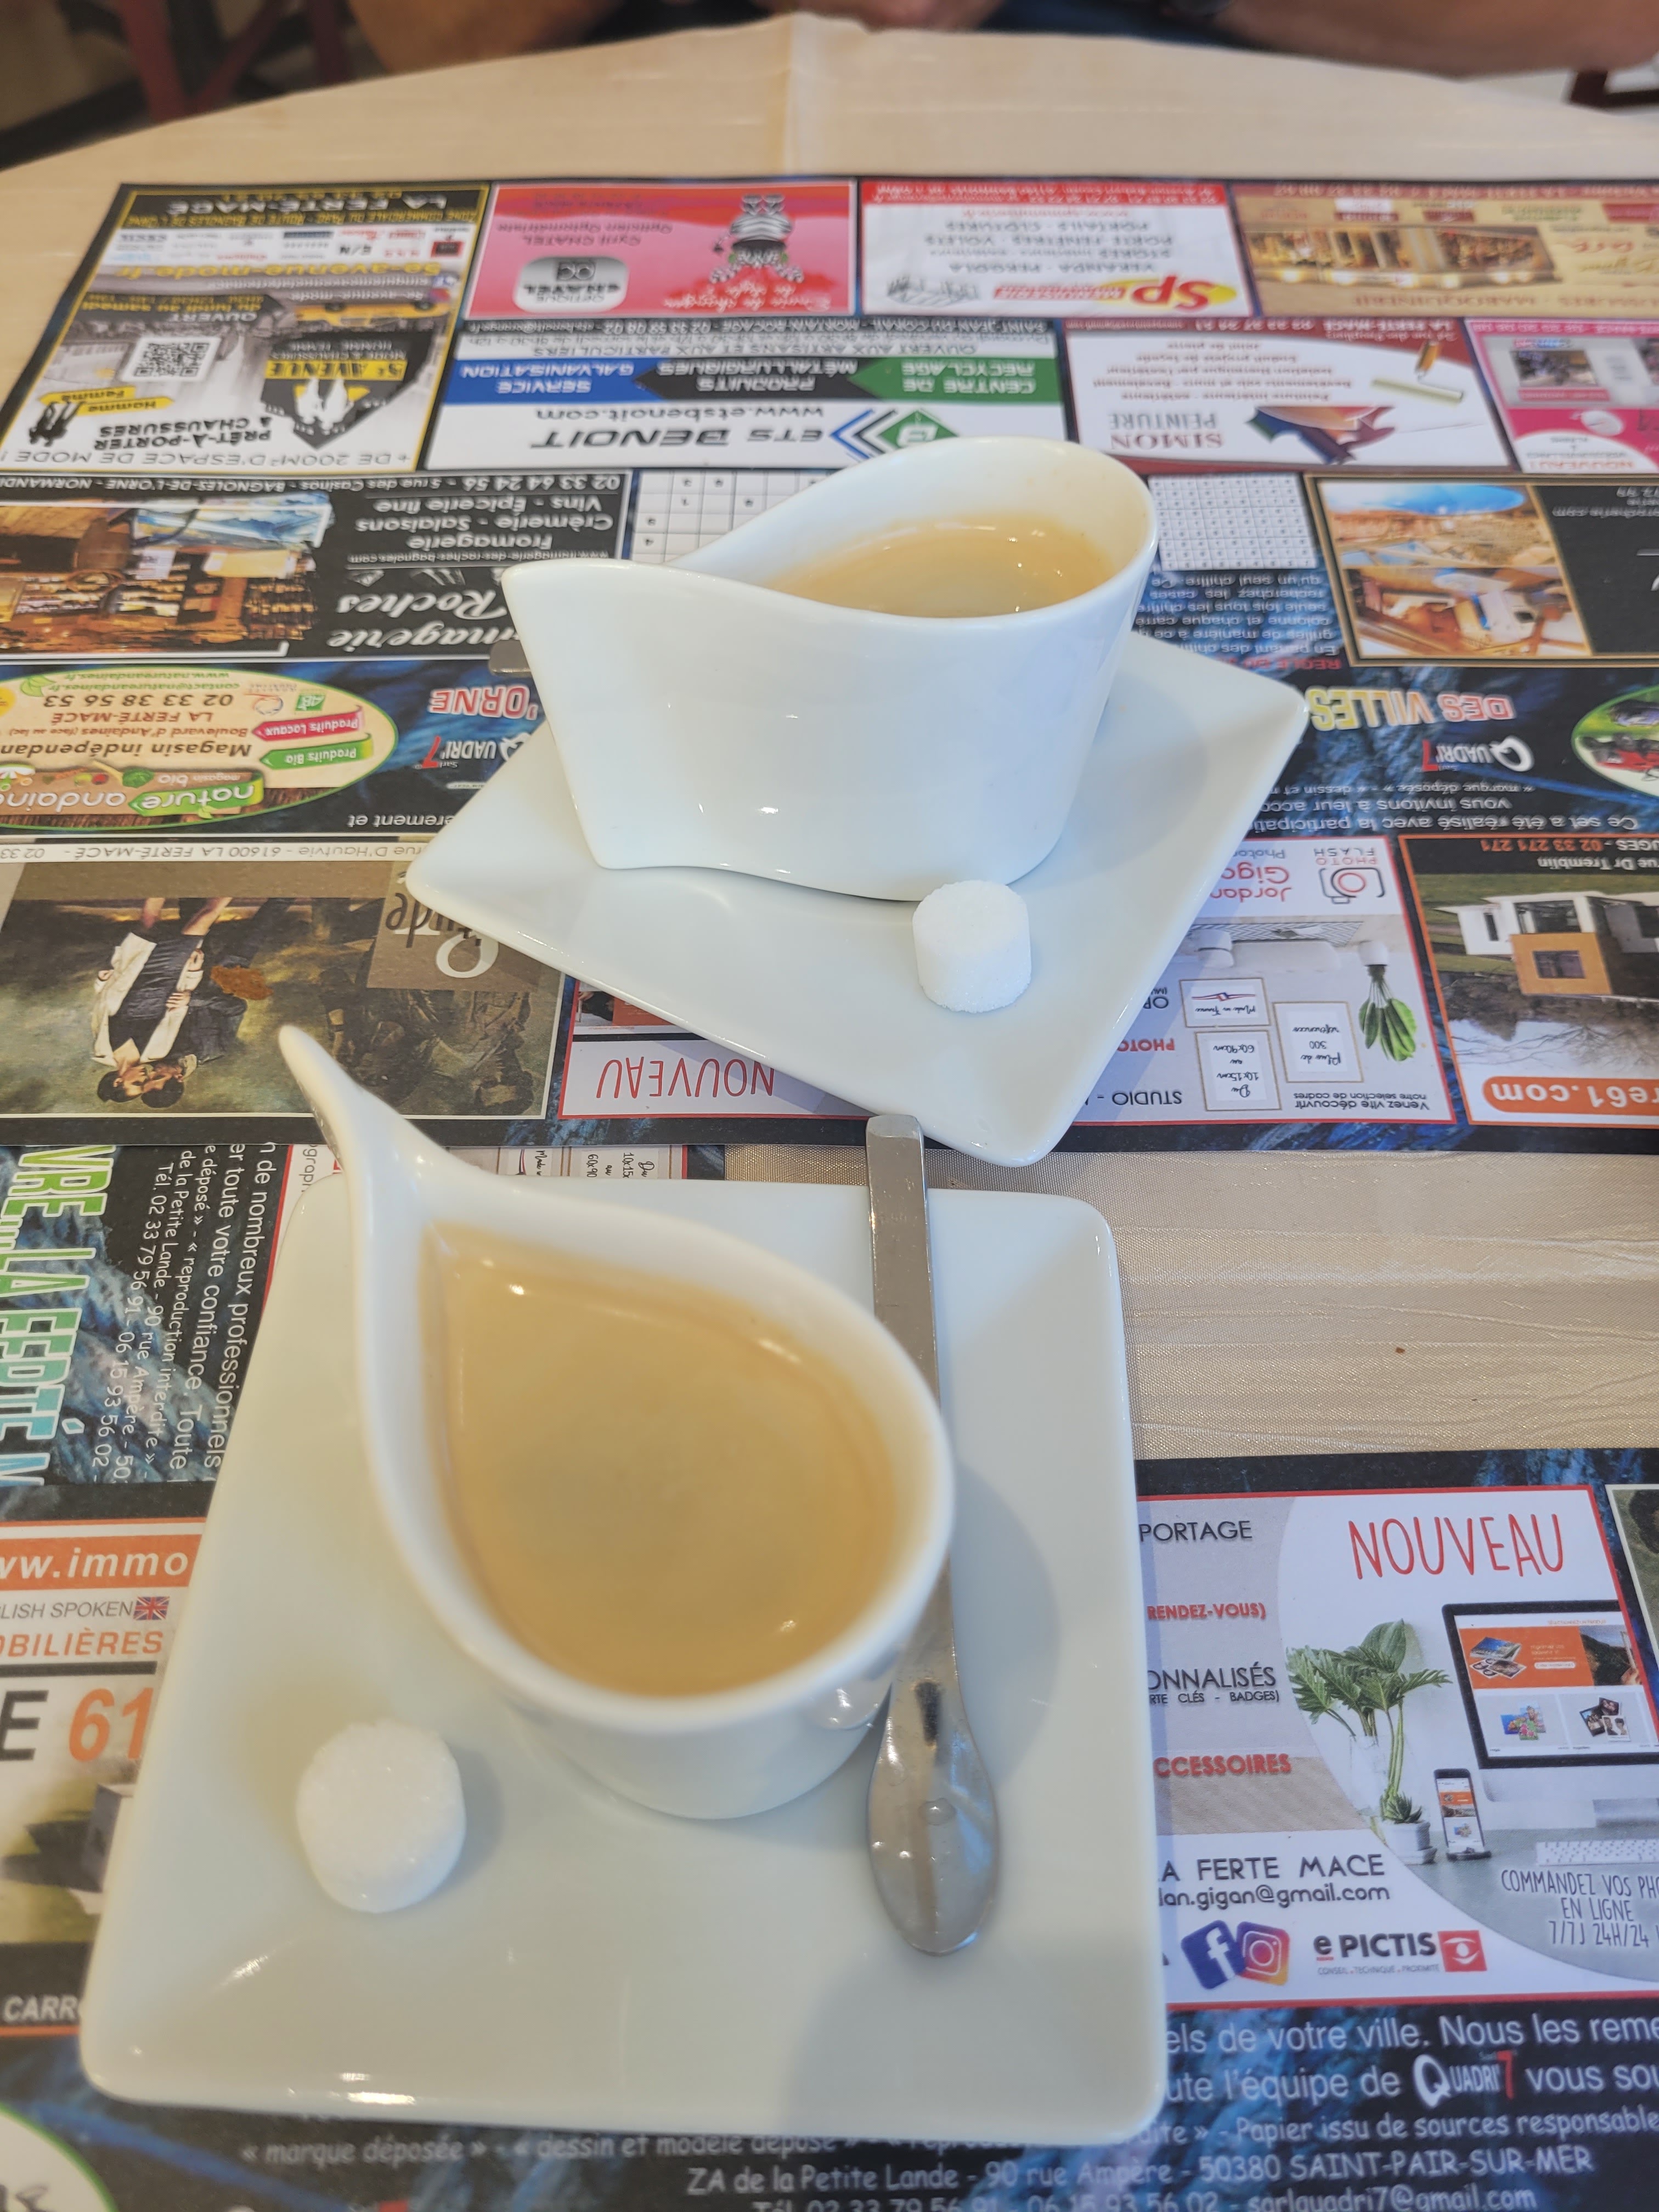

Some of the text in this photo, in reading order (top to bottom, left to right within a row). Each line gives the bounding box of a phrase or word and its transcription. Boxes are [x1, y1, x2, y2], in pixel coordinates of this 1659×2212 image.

[402, 194, 446, 209] LA
[171, 312, 257, 322] OUVERT
[533, 345, 978, 357] OUVERT AUX ARTISANS AUX PARTICULIERS
[268, 362, 365, 379] AVENUE
[461, 363, 634, 377] GALVANISATION
[901, 360, 1036, 377] RECYCLAGE
[496, 380, 592, 394] SERVICE
[697, 375, 815, 392] PRODUITS
[902, 378, 1036, 394] CENTRE DE
[61, 390, 125, 402] Femme
[88, 401, 156, 413] Homme
[535, 407, 823, 422] www.etsbenoit.com
[99, 417, 250, 438] CHAUSSURES
[1107, 413, 1216, 431] PEINTURE
[530, 428, 823, 449] ETS BENOIT
[1110, 432, 1222, 450] SIMON
[21, 450, 391, 465] DE D'ESPACE DE MODE
[105, 475, 621, 492] 02 33 64 24 56 des Casinos BAGNOLES-DE-L'ORNE
[374, 498, 421, 515] fine
[550, 496, 602, 512] Vins
[356, 515, 613, 533] Crèmerie Salaisons
[407, 533, 553, 551] Fromagerie
[1239, 576, 1271, 586] seul
[1150, 590, 1323, 600] recherchez les cases
[335, 589, 508, 620] Roches
[1215, 603, 1325, 613] seule tous
[1135, 615, 1329, 628] colonne chaque carré
[1195, 628, 1333, 640] grilles de manière
[1221, 644, 1250, 653] des
[65, 672, 230, 682] www.natureandaines.fr
[43, 694, 233, 707] 02 33 38 56 53
[1305, 686, 1515, 731] DES VILLES
[50, 712, 213, 726] LA FERTÉ-MACÉ
[82, 727, 247, 737] Boulevard d'Andaines
[264, 719, 358, 736] Produits Locaux
[152, 741, 252, 758] Magasin
[308, 748, 357, 760] Produits
[157, 773, 189, 787] bio
[140, 785, 254, 809] nature
[1313, 797, 1511, 812] vous invitons leur
[347, 814, 368, 827] et
[1383, 815, 1638, 830] Ce set réalisé avec
[76, 846, 388, 860] D'Hautvie FERTÉ-MACÉ
[1313, 848, 1374, 857] FLASH
[1480, 839, 1549, 851] 271 271
[1315, 856, 1377, 866] PHOTO
[1537, 857, 1638, 870] Dr Tremblin
[1210, 887, 1292, 902] Jordan
[1213, 1043, 1255, 1054] 60x90cm
[595, 1056, 775, 1099] NOUVEAU
[1217, 1071, 1259, 1082] 10x15cm
[1111, 1090, 1182, 1107] STUDIO
[1294, 1092, 1329, 1101] cadres
[1295, 1099, 1429, 1111] Venez vite découvrir
[129, 1162, 174, 1290] Tél. 02 33 79 56
[145, 1158, 218, 1449] déposé reproduction interdite
[121, 1190, 187, 1436] Petite Lande rue Ampère
[169, 1167, 243, 1470] toute votre confiance. Toute
[203, 1191, 269, 1468] nombreux professionnels
[1347, 1513, 1564, 1580] NOUVEAU
[50, 1599, 133, 1620] SPOKEN
[1177, 1689, 1280, 1703] CLÉS BADGES)
[68, 1685, 155, 1765] 61
[1197, 1854, 1386, 1881] FERTE MACE
[1501, 1869, 1633, 1897] COMMANDEZ VOS
[1589, 1897, 1634, 1922] LIGNE
[1592, 1922, 1650, 1948] 24H/24
[1340, 1932, 1437, 1959] PICTIS
[1267, 2013, 1581, 2051] votre Nous les
[1224, 2065, 1604, 2107] l'équipe de vous
[1236, 2114, 1509, 2146] Papier issu sources
[264, 2133, 616, 2172] marque déposée dessin
[800, 2143, 1594, 2191] Petite Lande Ampère 50380 SAINT-PAIR-SUR-MER
